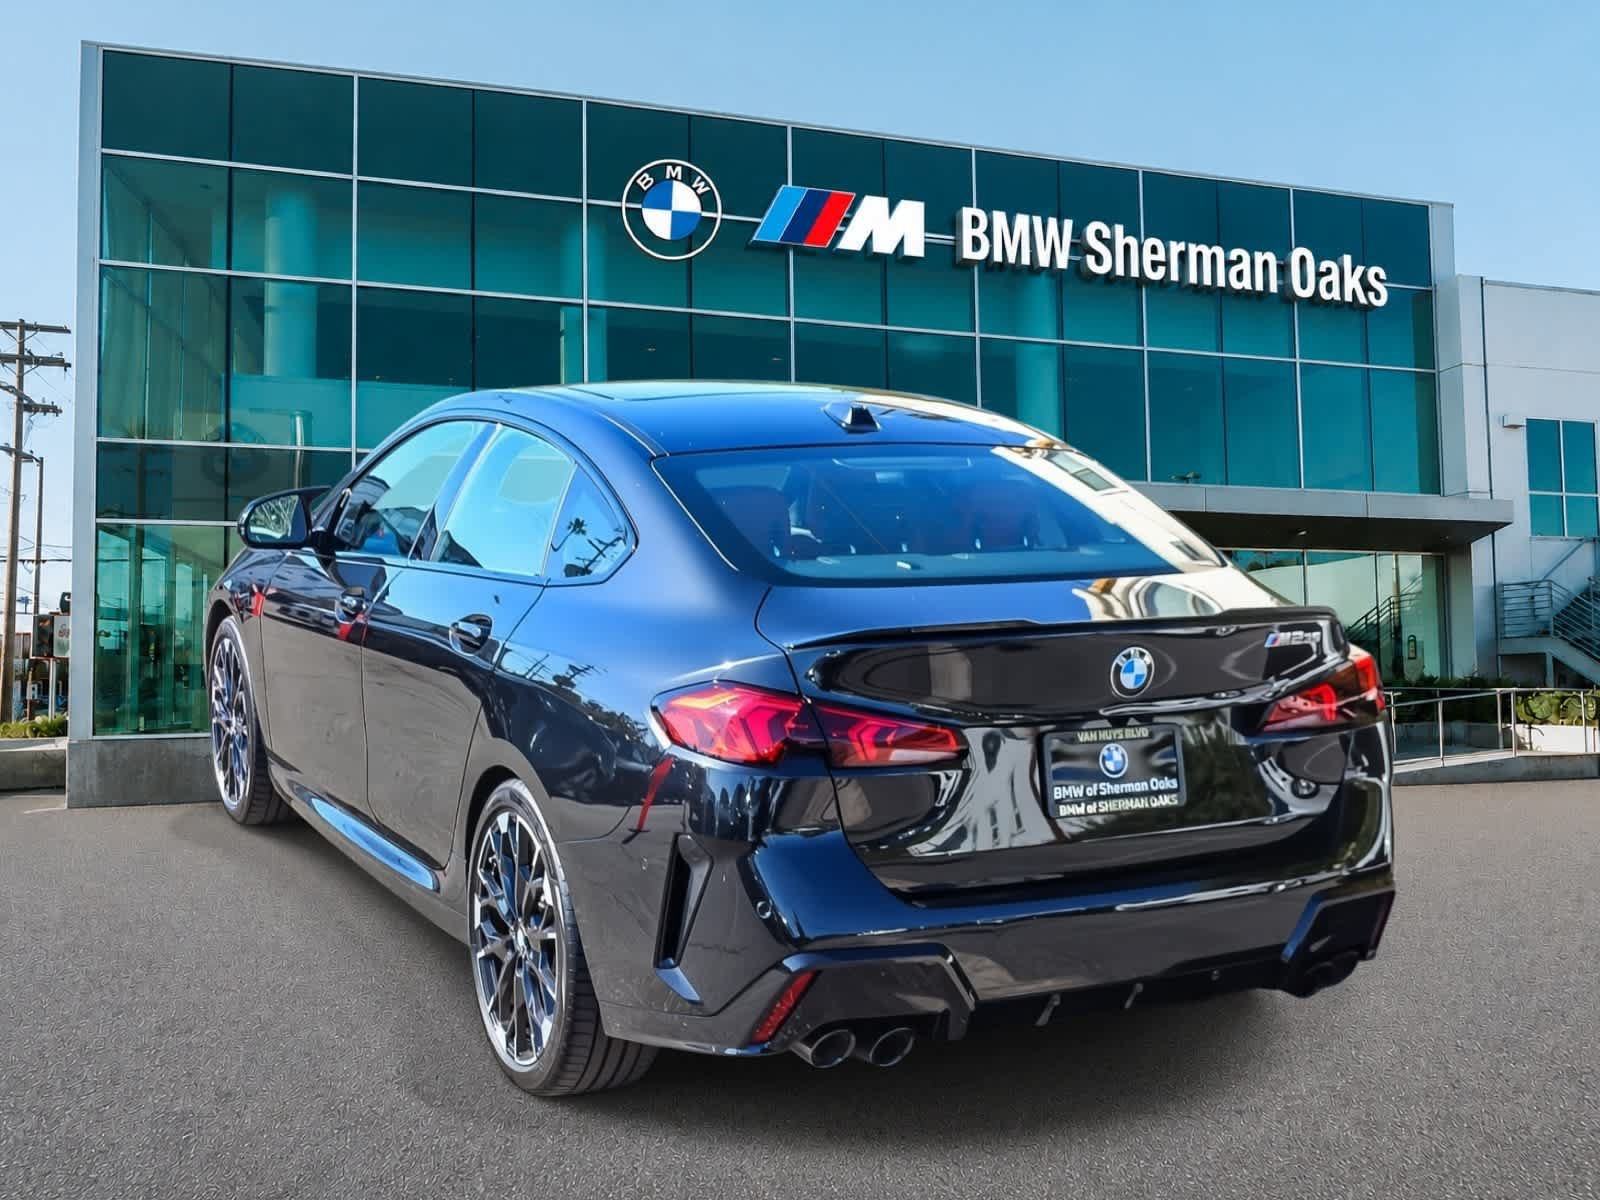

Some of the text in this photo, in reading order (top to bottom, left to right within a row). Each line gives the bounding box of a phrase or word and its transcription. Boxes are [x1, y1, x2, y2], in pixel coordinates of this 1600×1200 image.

[636, 165, 710, 196] BMW
[836, 195, 925, 257] M
[961, 207, 1388, 308] BMW Sherman Oaks
[1077, 731, 1097, 742] VAN
[1125, 727, 1149, 739] BLVD
[1053, 777, 1178, 800] BMW of Sherman Oaks
[1059, 794, 1178, 816] BMW of SHERMAN OAKS
